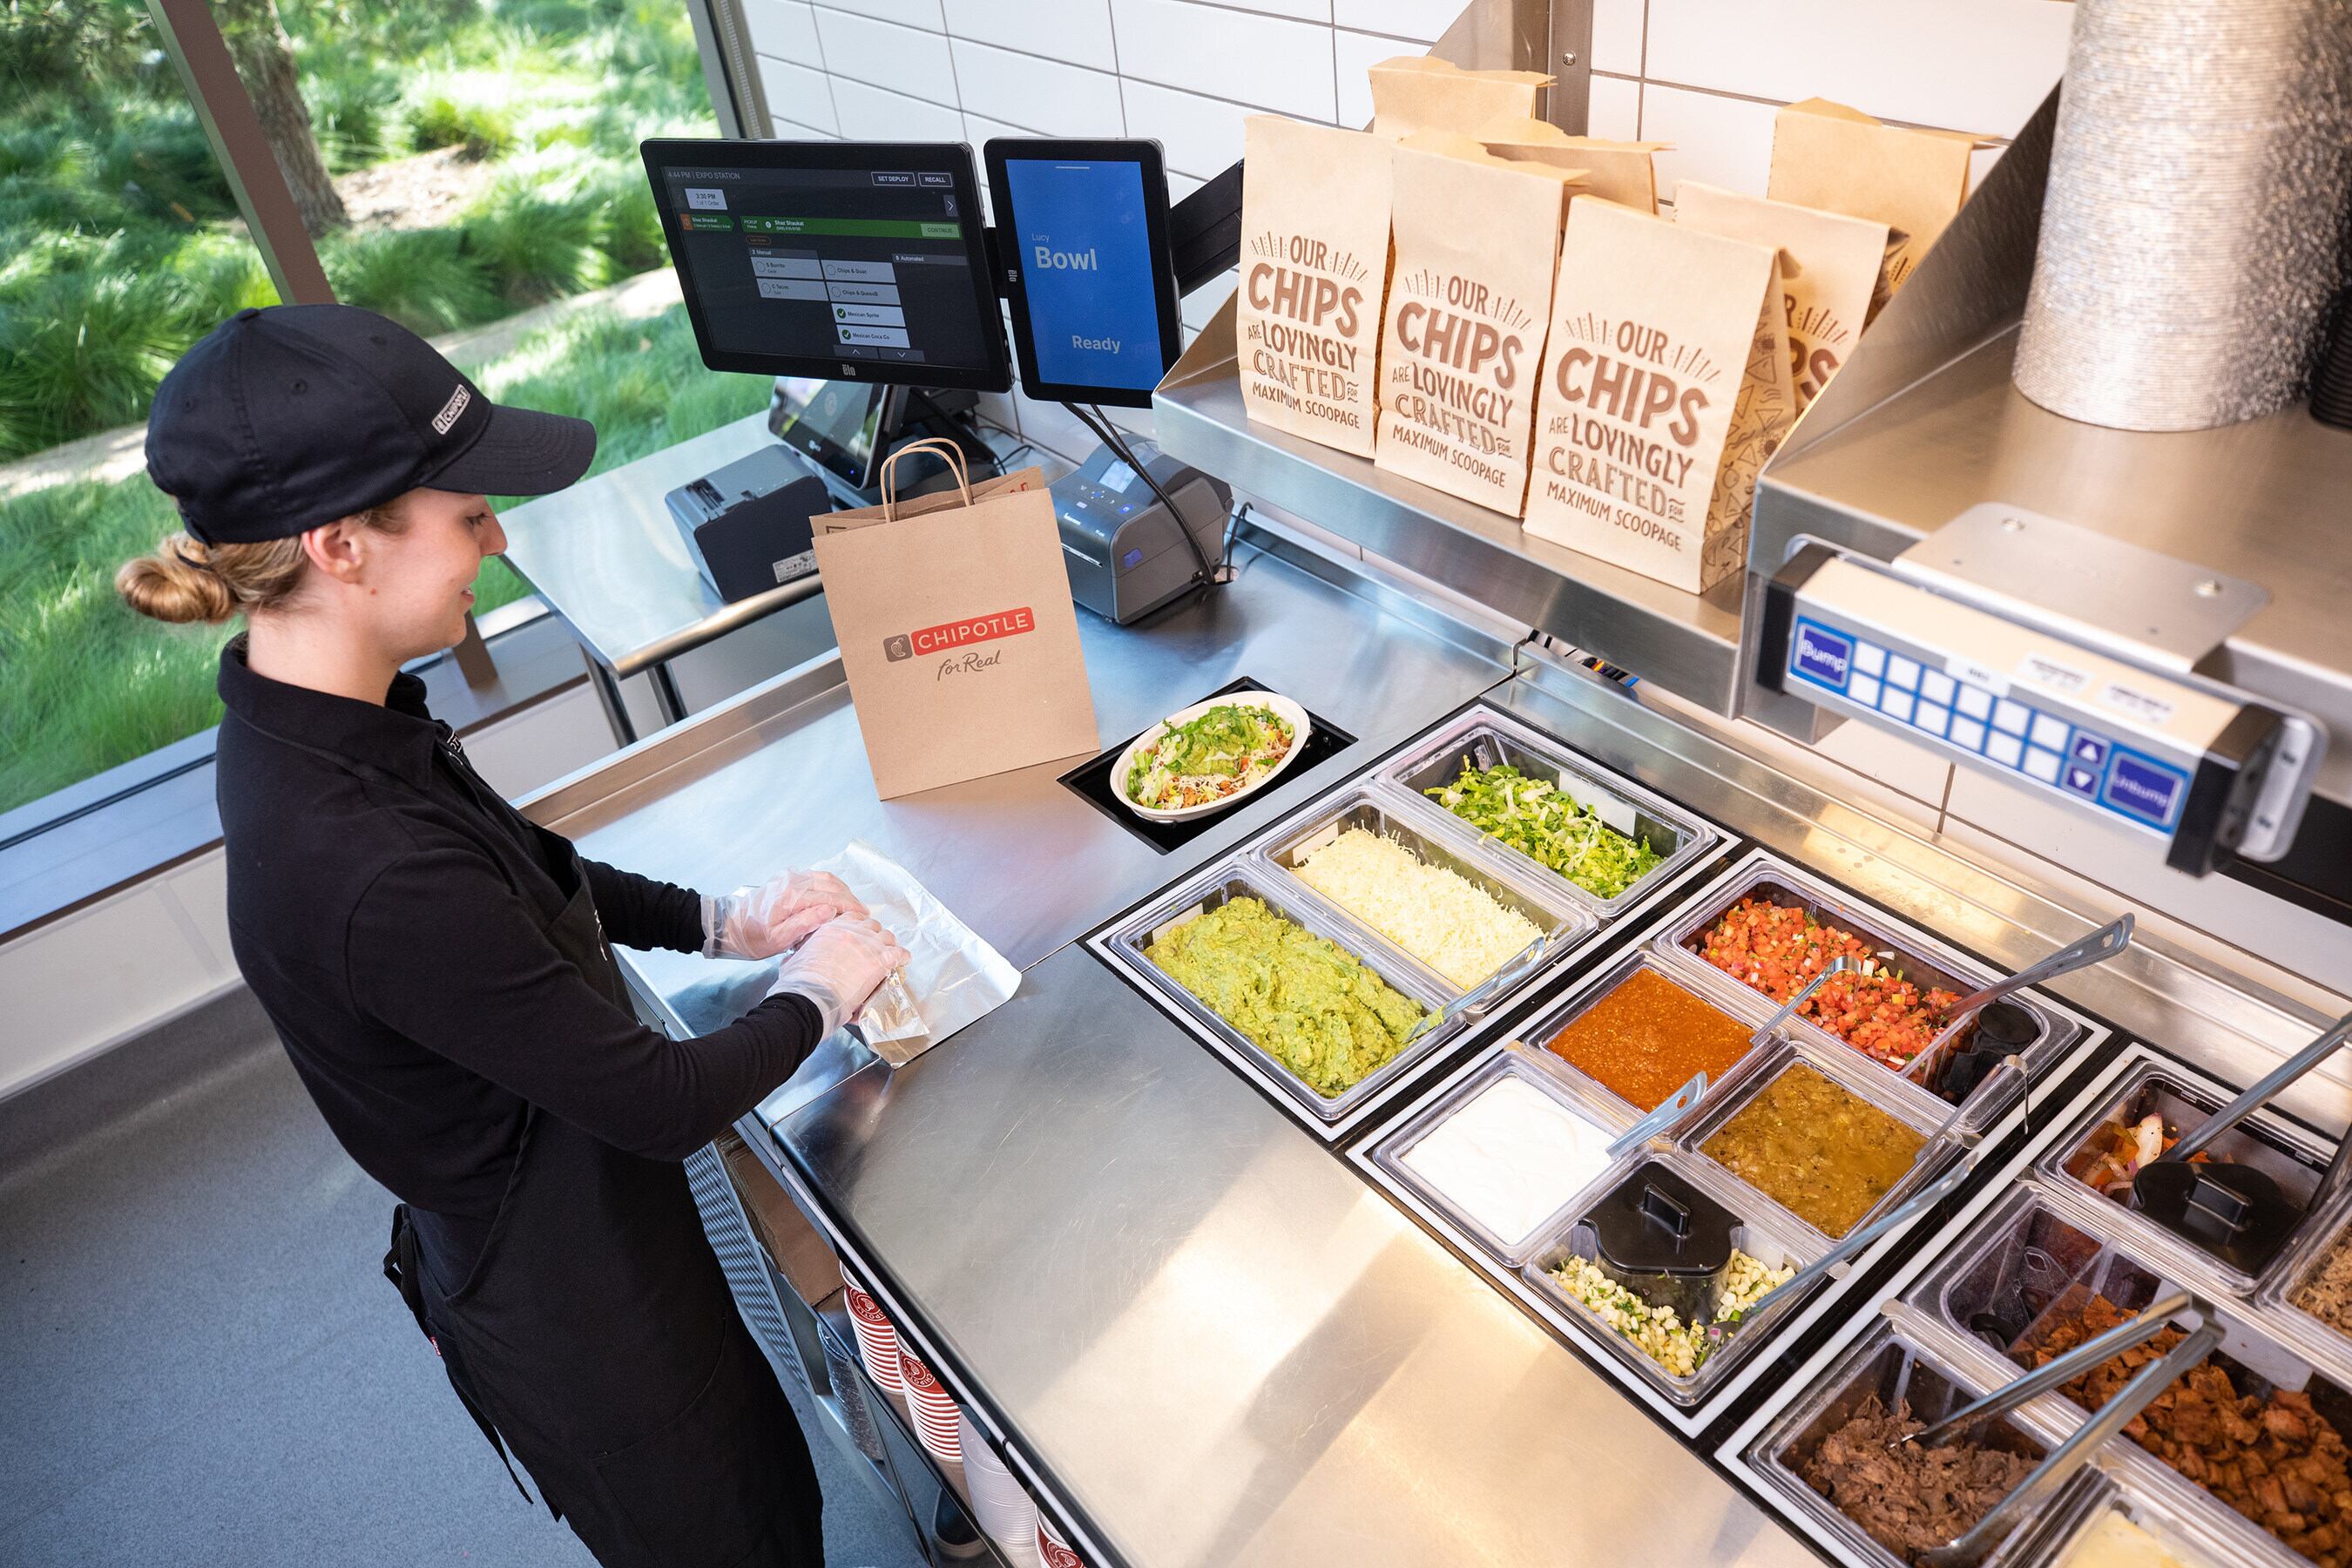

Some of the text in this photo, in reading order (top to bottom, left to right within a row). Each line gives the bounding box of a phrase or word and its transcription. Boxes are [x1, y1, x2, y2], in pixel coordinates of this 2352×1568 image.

[1031, 233, 1050, 242] Lucy
[1034, 246, 1098, 271] Bowl
[1289, 235, 1328, 271] OUR
[1248, 262, 1363, 338] CHIPS
[1448, 275, 1489, 315] OUR
[1071, 335, 1121, 355] Ready
[1247, 320, 1356, 373] ARE LOVINGLY
[1396, 301, 1524, 389] CHIPS
[1617, 321, 1668, 365] OUR
[1253, 348, 1346, 402] CRAFTED
[1392, 362, 1513, 429] ARE LOVINGLY
[1557, 347, 1710, 447] CHIPS
[1252, 382, 1360, 429] MAXIMUM SCOOPAGE
[1395, 394, 1496, 455] CRAFTED
[1392, 424, 1506, 488] MAXIMUM SCOOPAGE
[1549, 413, 1694, 489] ARE LOVINGLY
[1549, 446, 1667, 517] CRAFTED
[1547, 481, 1682, 551] MAXIMUM SCOOPAGE
[917, 612, 1029, 650] CHIPOTLE
[1800, 639, 1847, 673] Bump
[936, 650, 1002, 681] for Real
